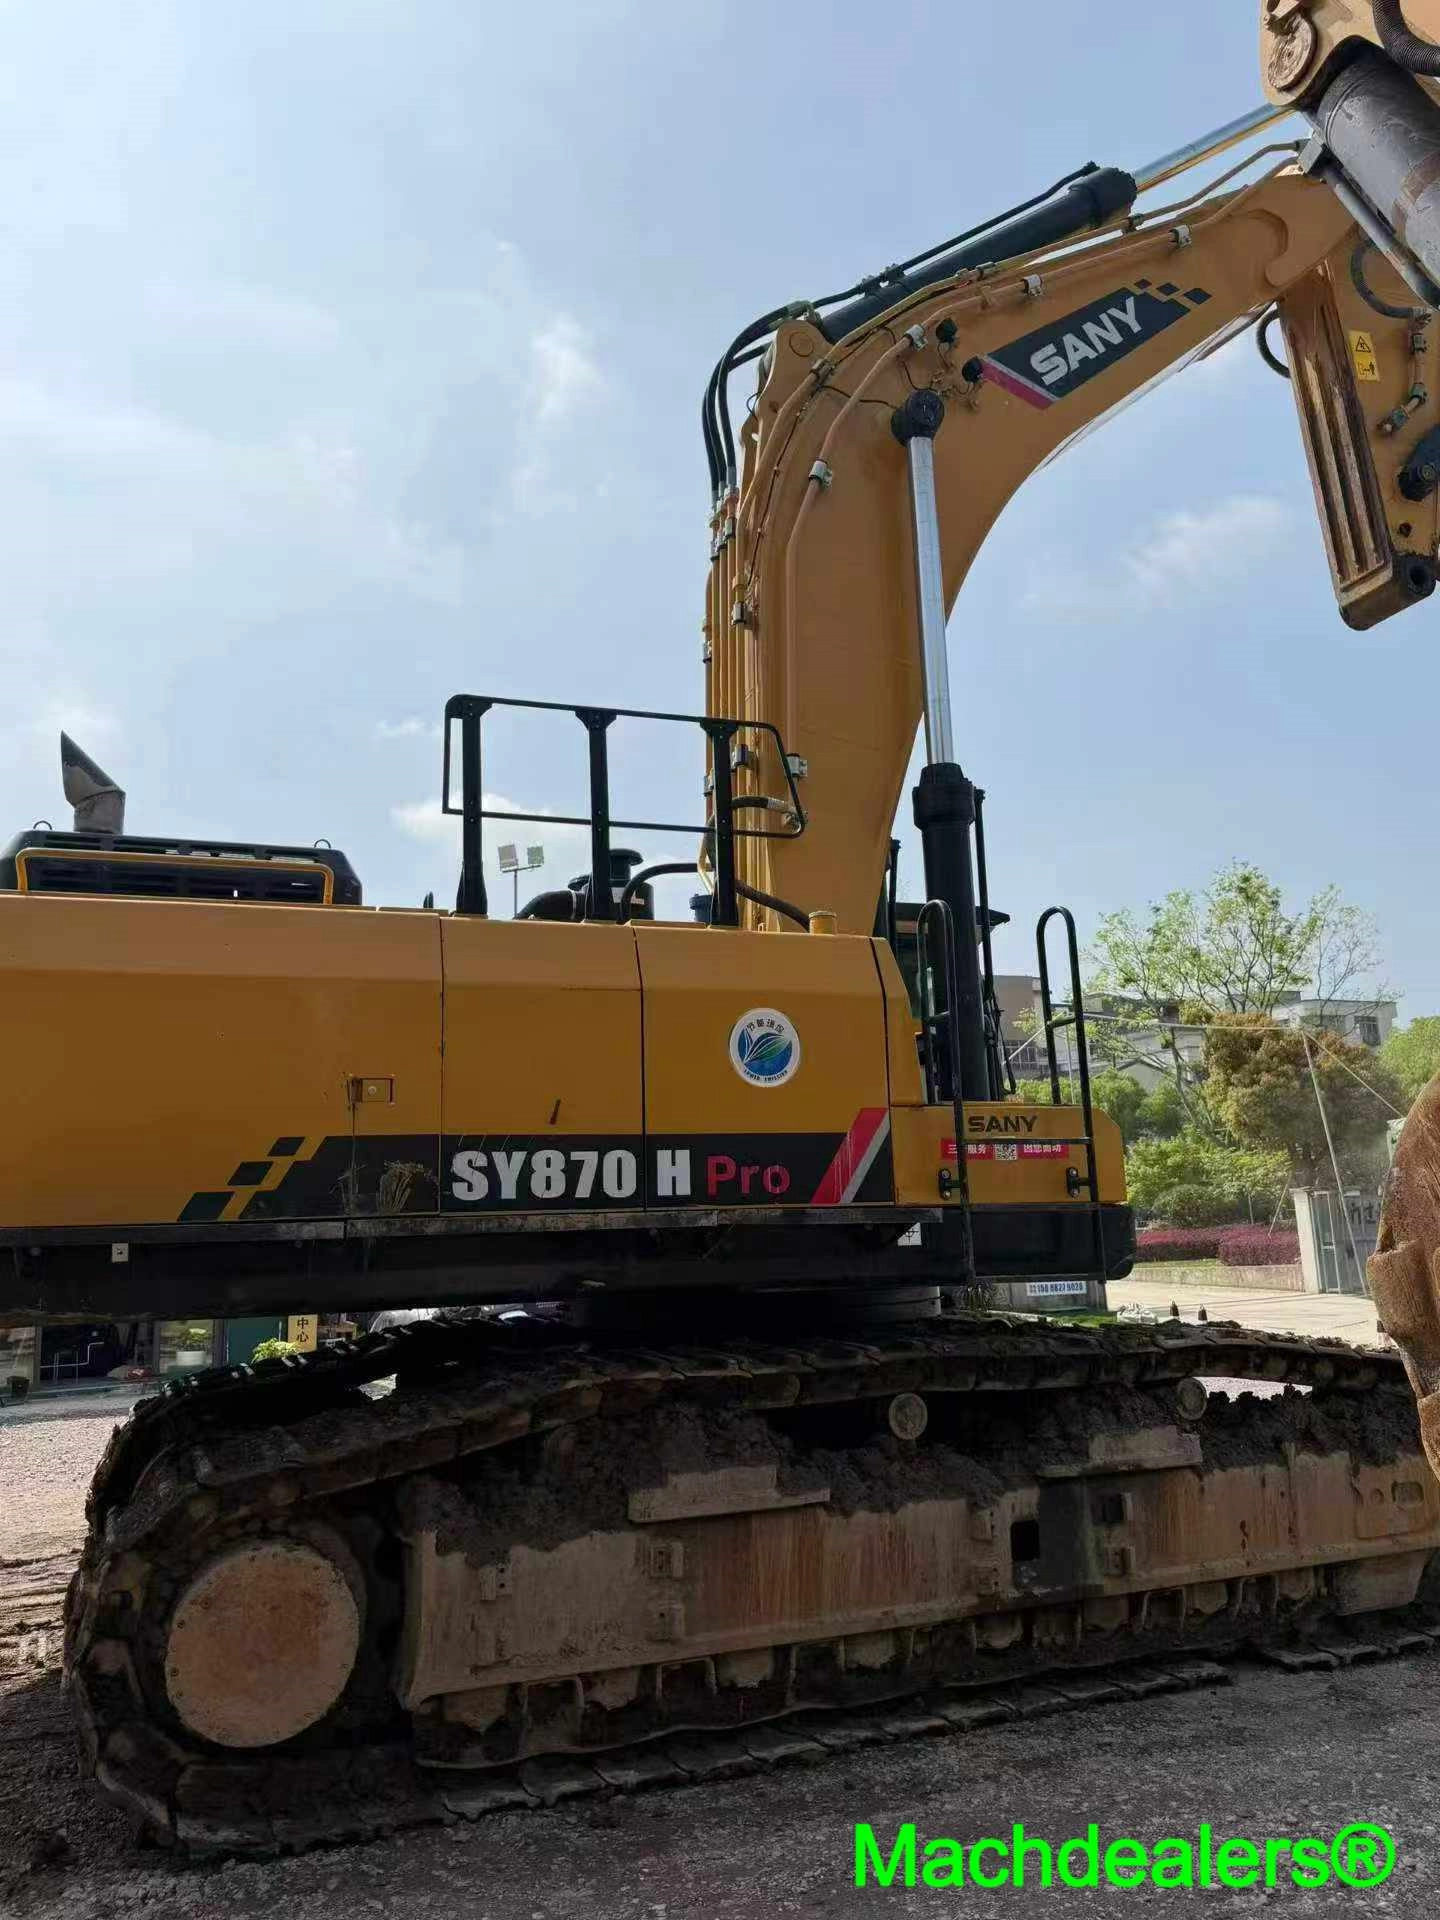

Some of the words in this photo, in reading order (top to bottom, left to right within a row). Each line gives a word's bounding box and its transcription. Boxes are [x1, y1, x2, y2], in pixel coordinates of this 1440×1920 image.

[1030, 296, 1142, 386] SANY
[968, 1115, 1037, 1133] SANY
[451, 1149, 638, 1201] SY870
[656, 1149, 692, 1197] H
[706, 1154, 791, 1197] Pro
[296, 1316, 310, 1343] 中心
